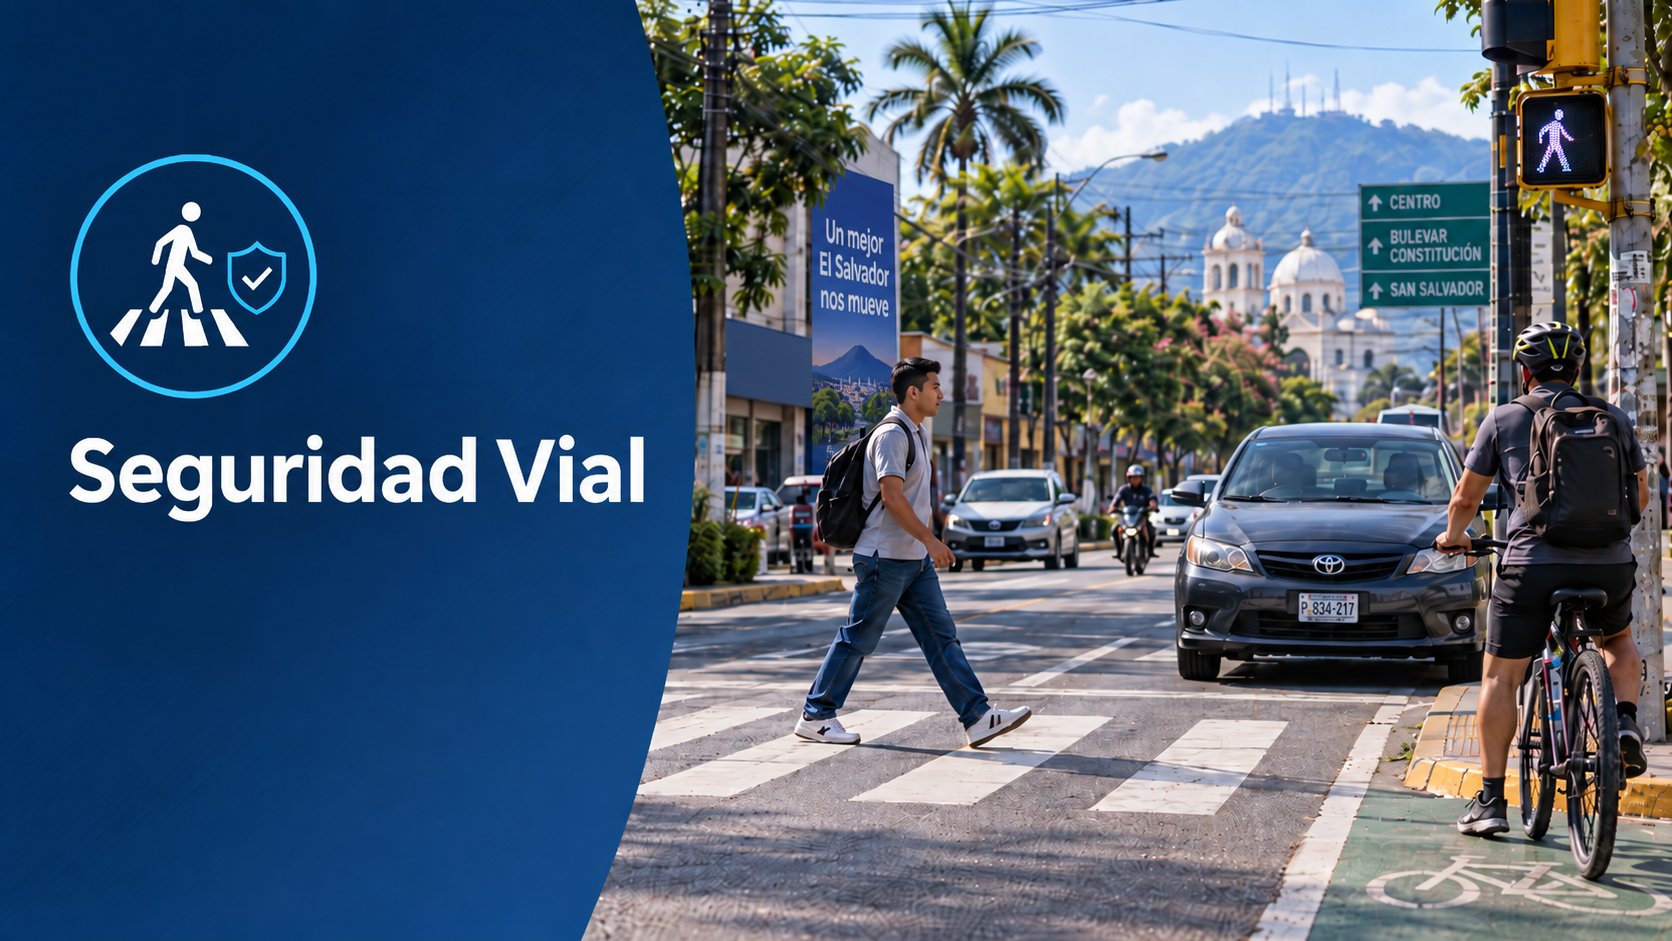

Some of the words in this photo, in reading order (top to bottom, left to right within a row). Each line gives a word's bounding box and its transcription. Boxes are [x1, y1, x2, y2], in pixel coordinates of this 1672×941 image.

[1389, 194, 1441, 210] CENTRO
[825, 217, 844, 247] Un
[847, 227, 884, 258] mejor
[1390, 228, 1448, 245] BULEVAR
[1390, 242, 1482, 263] CONSTITUCIÓN
[819, 251, 832, 277] El
[835, 253, 890, 287] Salvador
[1390, 282, 1416, 297] SAN
[1419, 280, 1484, 297] SALVADOR
[820, 289, 845, 311] nos
[848, 294, 889, 318] mueve
[1301, 601, 1308, 615] P
[1312, 601, 1355, 615] 834-217
